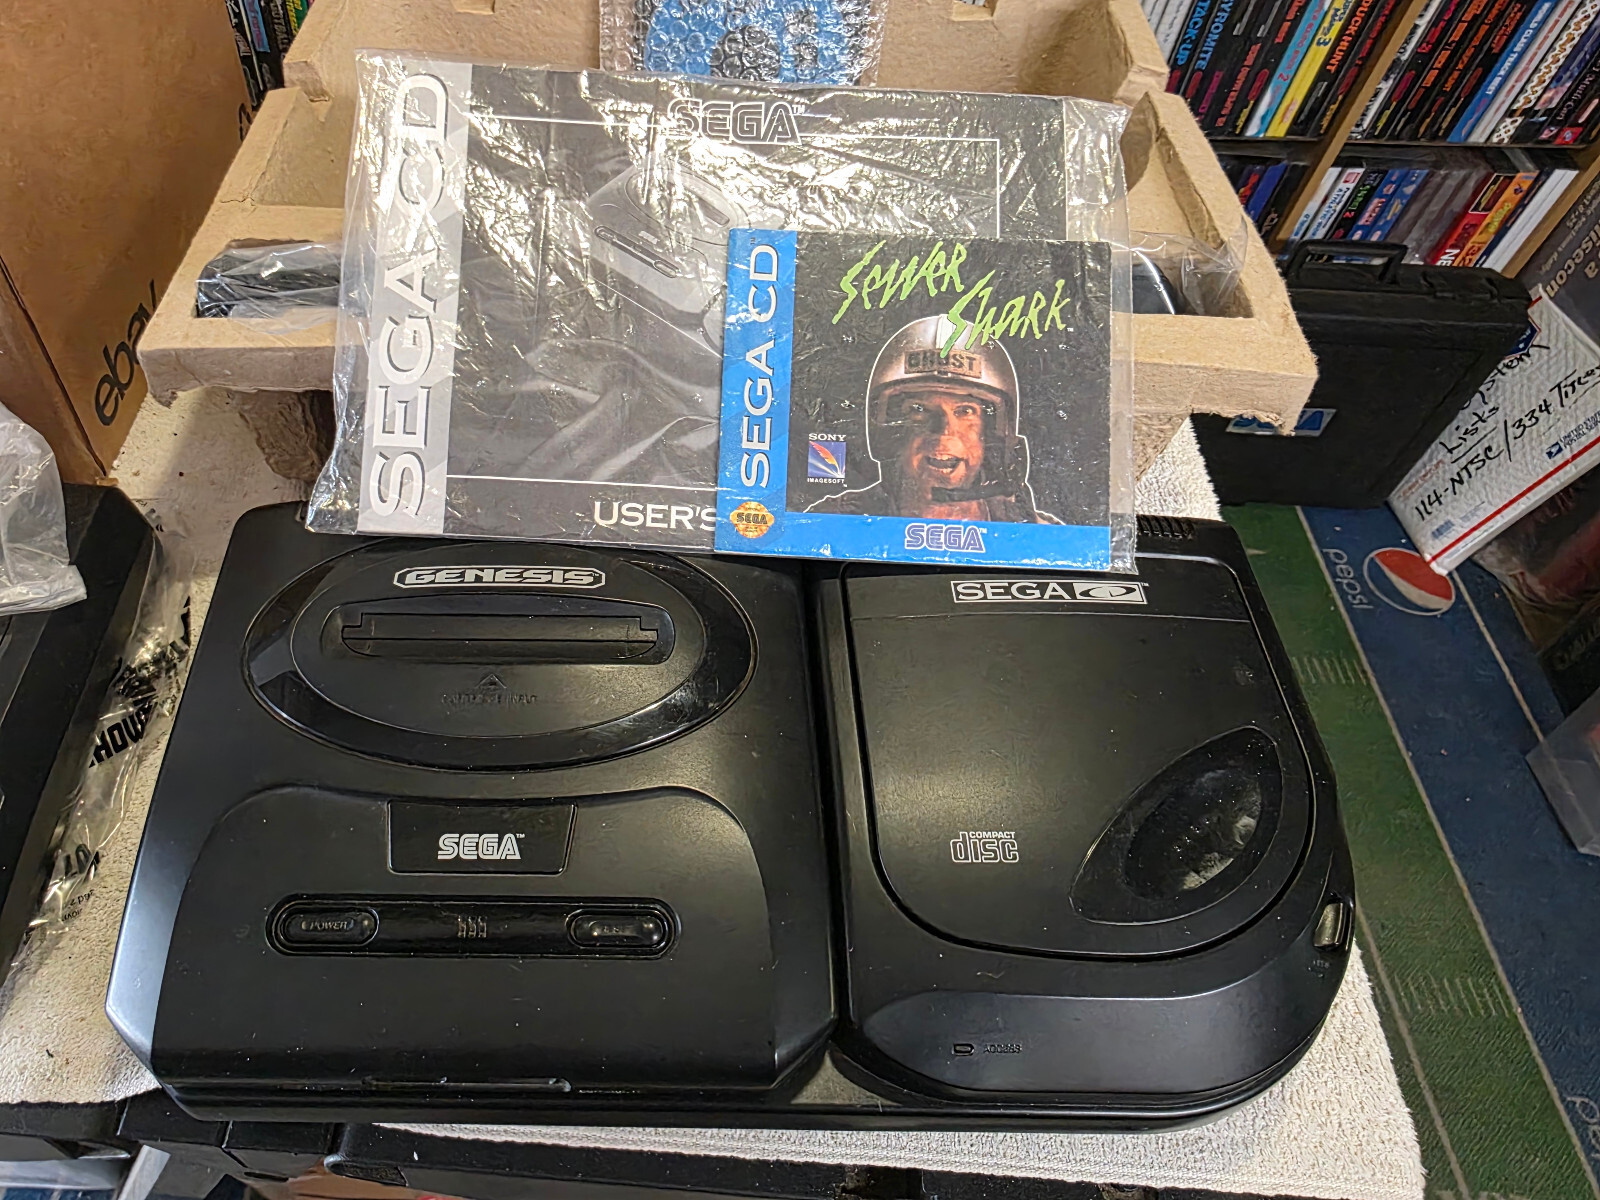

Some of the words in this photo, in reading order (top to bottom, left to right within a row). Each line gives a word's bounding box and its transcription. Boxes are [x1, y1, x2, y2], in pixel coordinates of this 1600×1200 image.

[1347, 0, 1373, 36] DUCK
[1530, 2, 1551, 29] WORLD
[1316, 36, 1332, 46] 3
[1513, 29, 1533, 52] CLASS
[1326, 36, 1353, 74] HUNT
[1498, 52, 1519, 76] TRACK
[1277, 72, 1290, 81] 2
[667, 97, 802, 145] SEGA
[748, 243, 779, 324] CD
[369, 244, 438, 517] SEGA
[740, 340, 775, 488] SEGA
[808, 433, 847, 442] SONY
[593, 501, 717, 531] USER'S
[736, 512, 768, 525] SEGA
[904, 522, 984, 553] SEGA
[404, 567, 598, 586] GENESIS
[1322, 547, 1376, 611] pepsi
[956, 582, 1072, 601] SEGA
[437, 833, 521, 860] SEGA
[950, 831, 1019, 863] disc
[969, 830, 1016, 839] COMPACT
[309, 920, 348, 931] POWER
